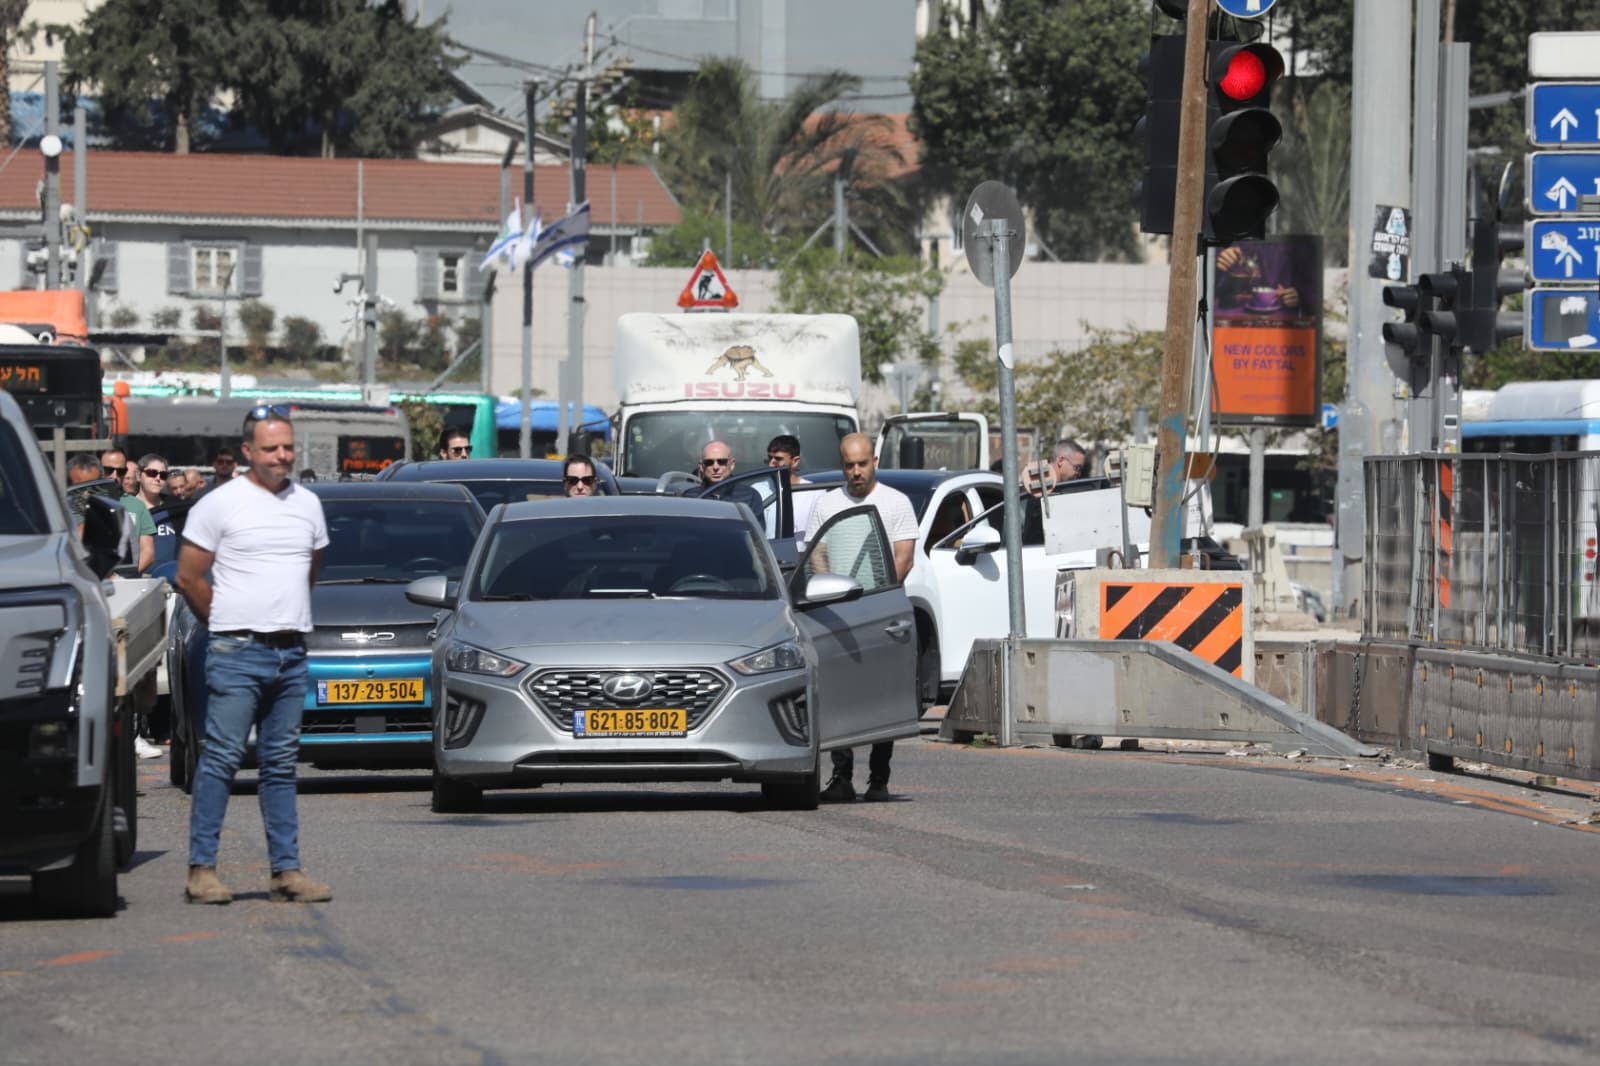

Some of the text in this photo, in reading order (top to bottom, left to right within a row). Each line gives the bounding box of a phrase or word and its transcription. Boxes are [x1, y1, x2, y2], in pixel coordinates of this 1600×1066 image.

[1224, 344, 1307, 358] NEW COLORS
[1233, 359, 1297, 371] BY FATTAL
[684, 382, 796, 399] ISUZU
